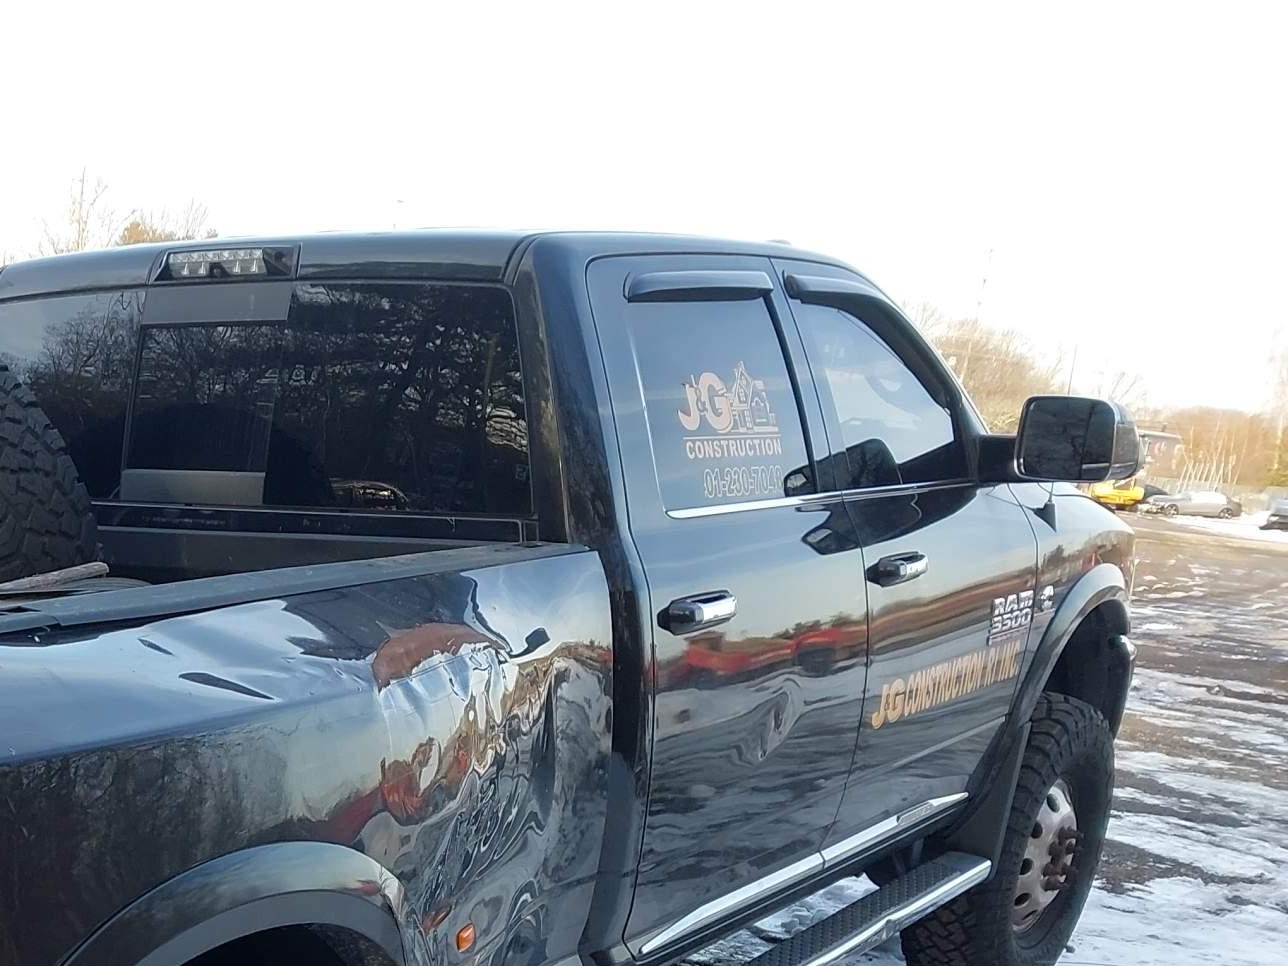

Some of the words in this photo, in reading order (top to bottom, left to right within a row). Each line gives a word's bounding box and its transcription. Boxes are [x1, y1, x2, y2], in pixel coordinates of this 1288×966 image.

[685, 437, 782, 460] CONSTRUCTION
[993, 589, 1034, 616] RAM
[991, 607, 1033, 634] 3500
[903, 650, 986, 718] CONSTRUCTION
